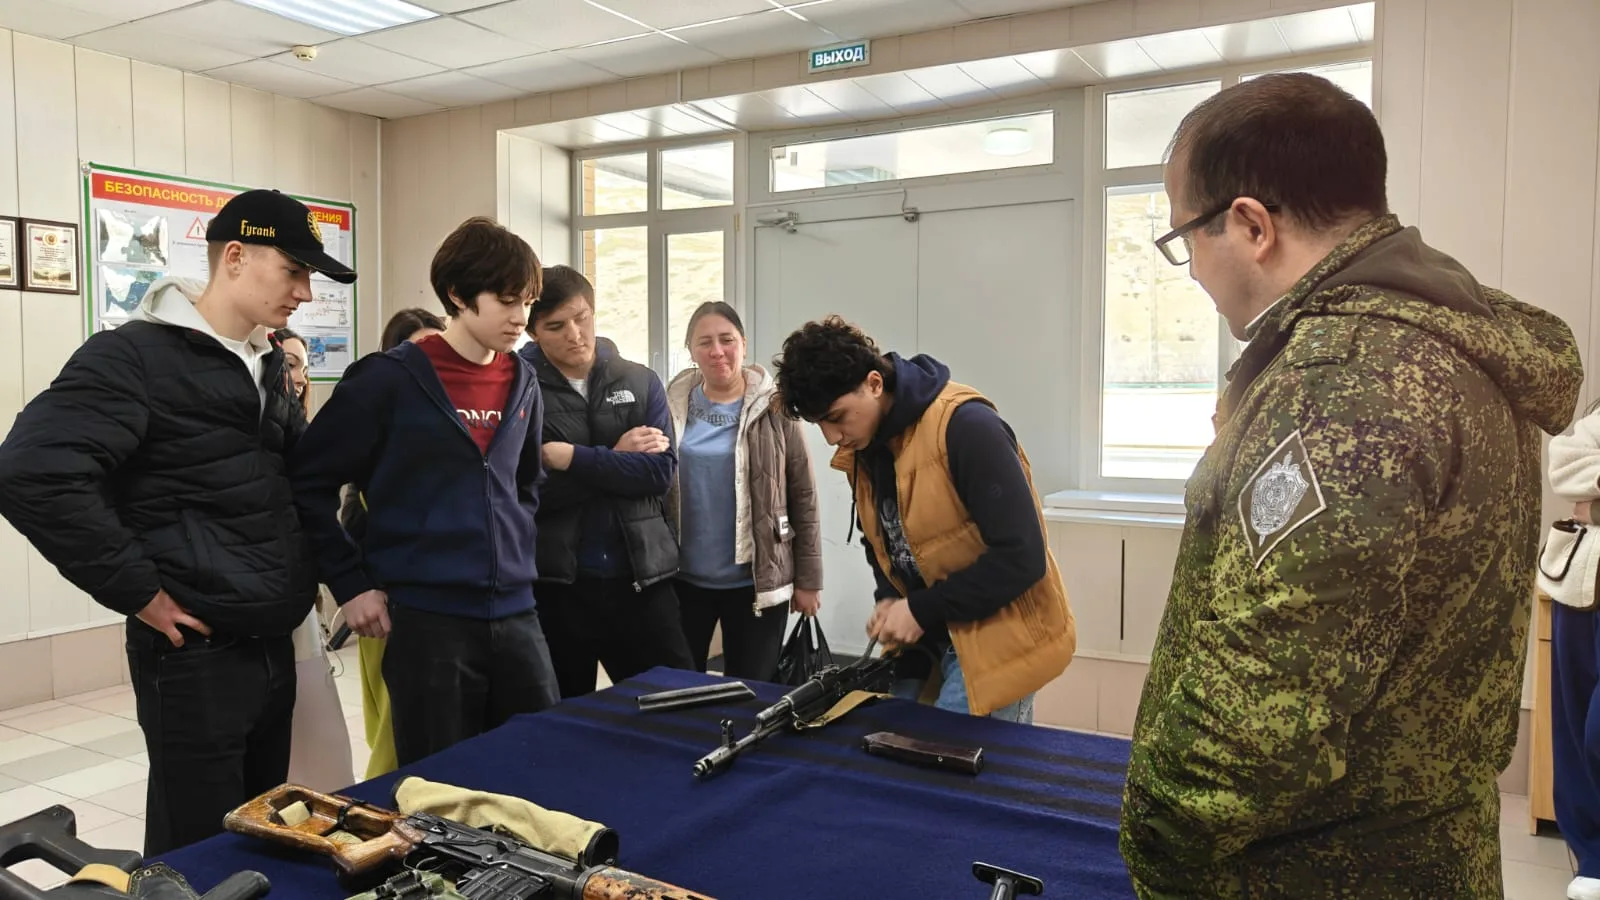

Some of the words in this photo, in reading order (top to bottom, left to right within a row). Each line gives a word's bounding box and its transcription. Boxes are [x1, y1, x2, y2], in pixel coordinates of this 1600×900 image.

[815, 47, 864, 66] ВЫХОД
[105, 181, 213, 206] БЕЗОПАСНОСТЬ
[241, 219, 276, 237] Fyrank
